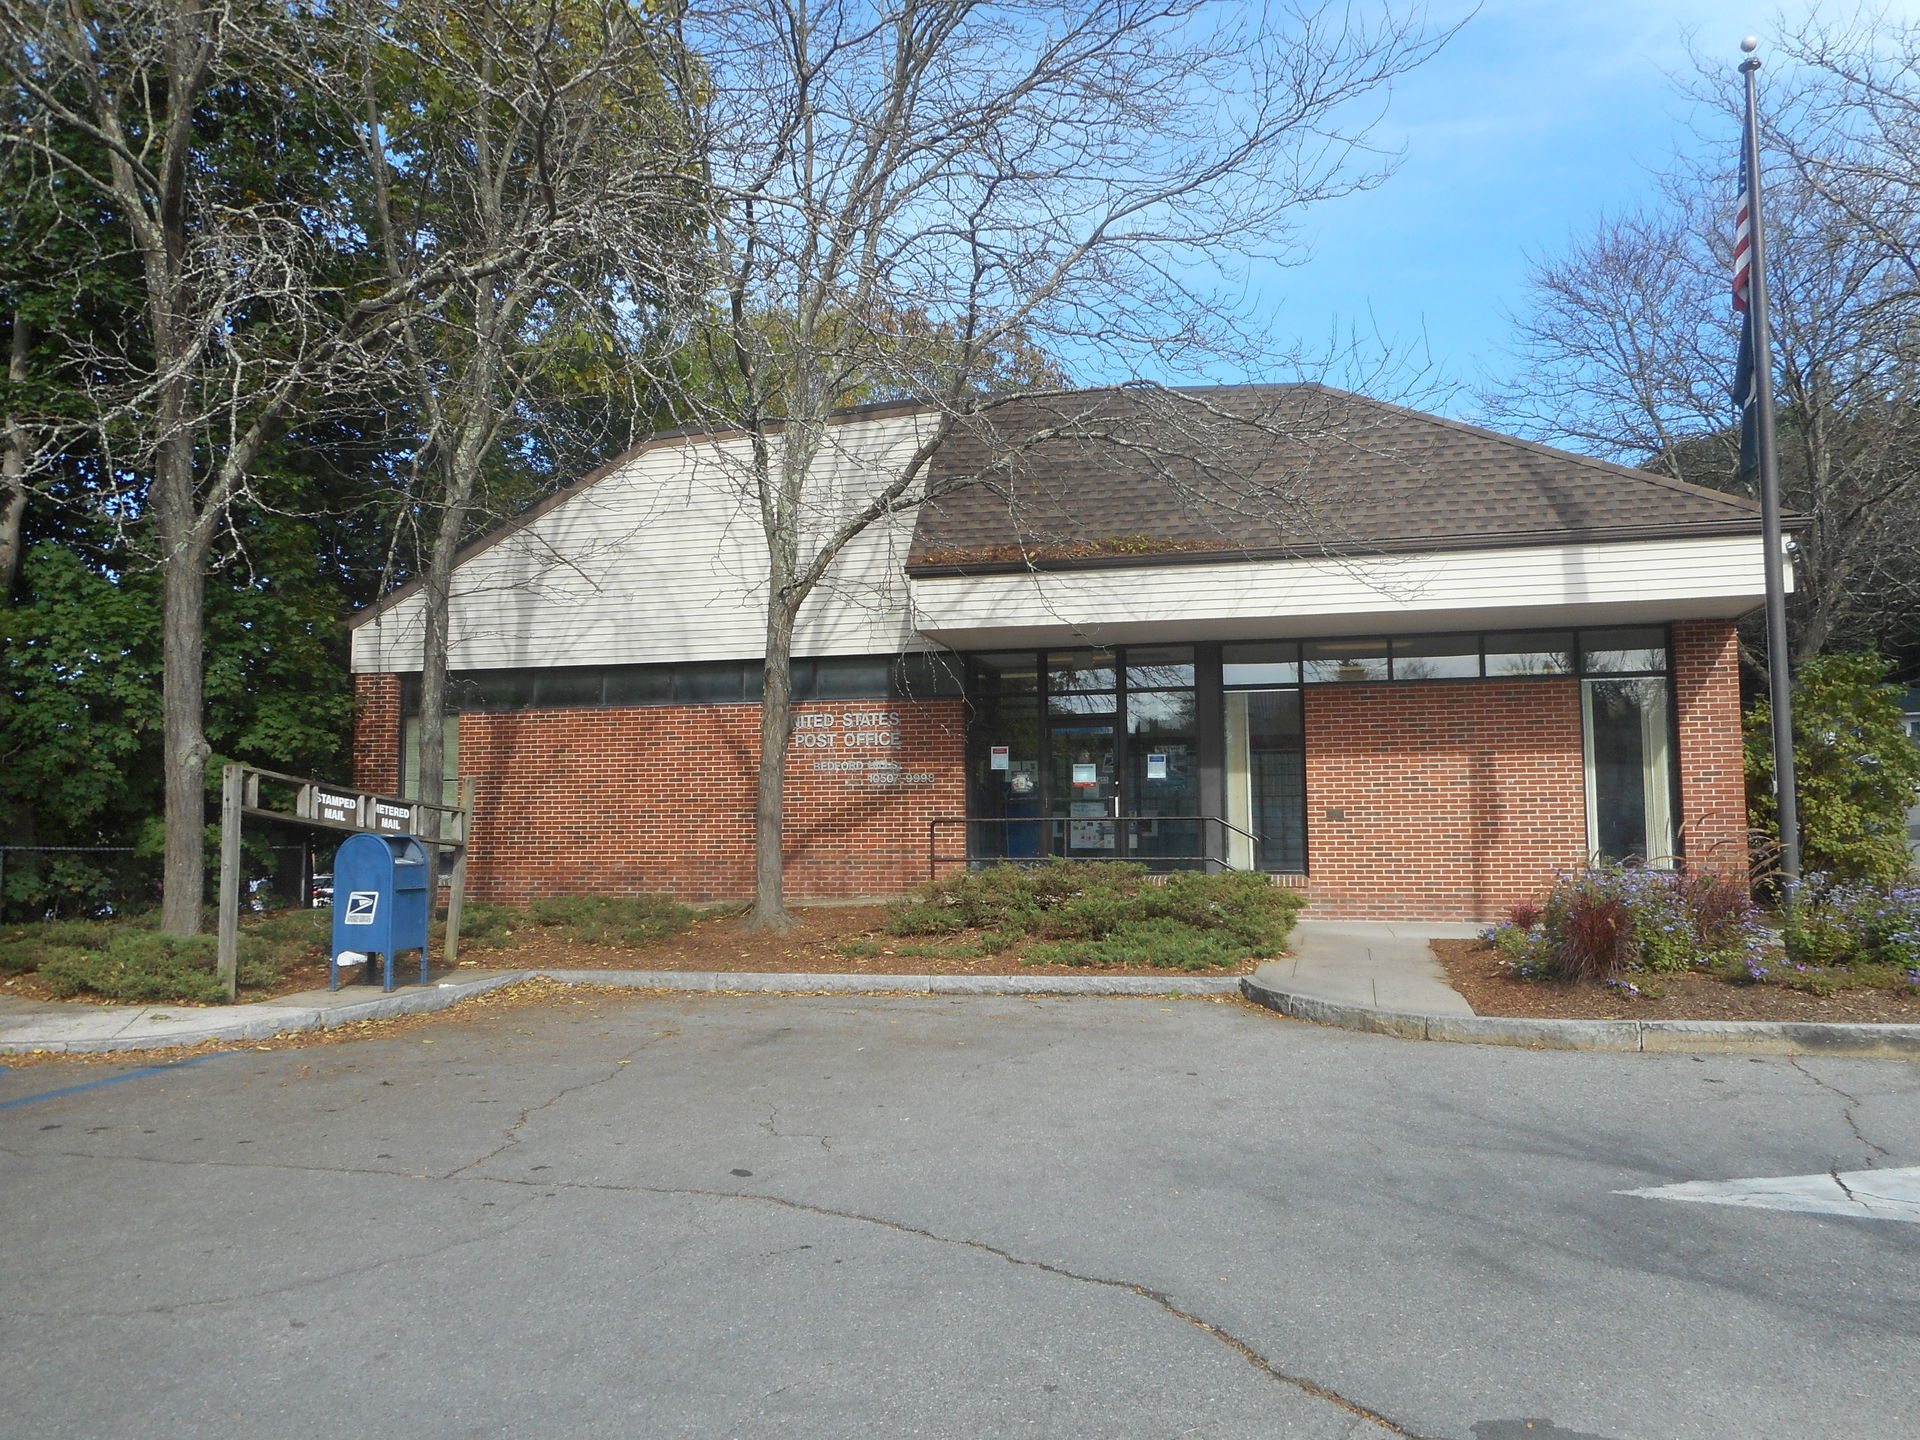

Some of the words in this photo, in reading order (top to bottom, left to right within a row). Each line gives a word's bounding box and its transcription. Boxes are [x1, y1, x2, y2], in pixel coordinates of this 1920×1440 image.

[843, 712, 899, 727] STATES
[795, 733, 836, 748] POST
[844, 732, 900, 747] OFFICE
[814, 761, 864, 771] BEDFORD
[317, 793, 356, 809] STAMPED
[324, 808, 346, 821] MAIL
[381, 818, 401, 830] MAIL
